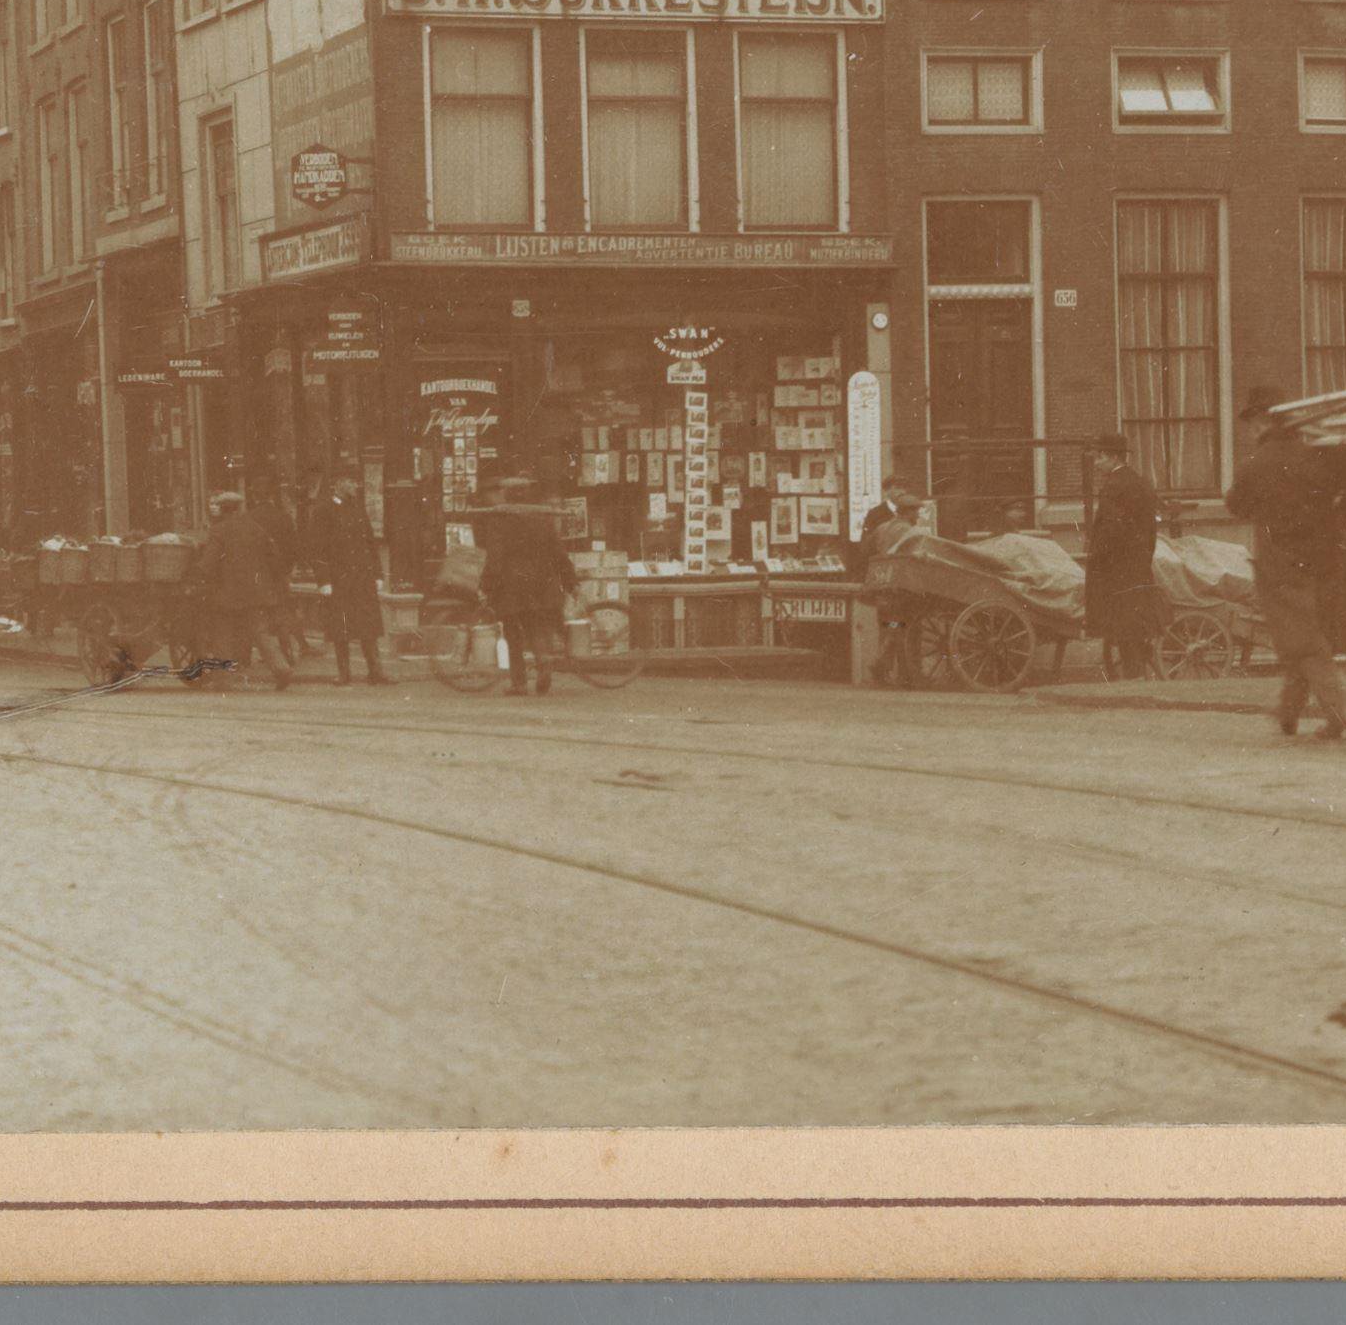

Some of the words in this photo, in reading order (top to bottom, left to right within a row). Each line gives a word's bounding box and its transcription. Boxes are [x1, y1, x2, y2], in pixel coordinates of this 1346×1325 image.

[496, 234, 559, 258] LIJSTEN
[577, 235, 696, 254] ENCADREMENTEN
[635, 246, 729, 260] ADVERTENTIE
